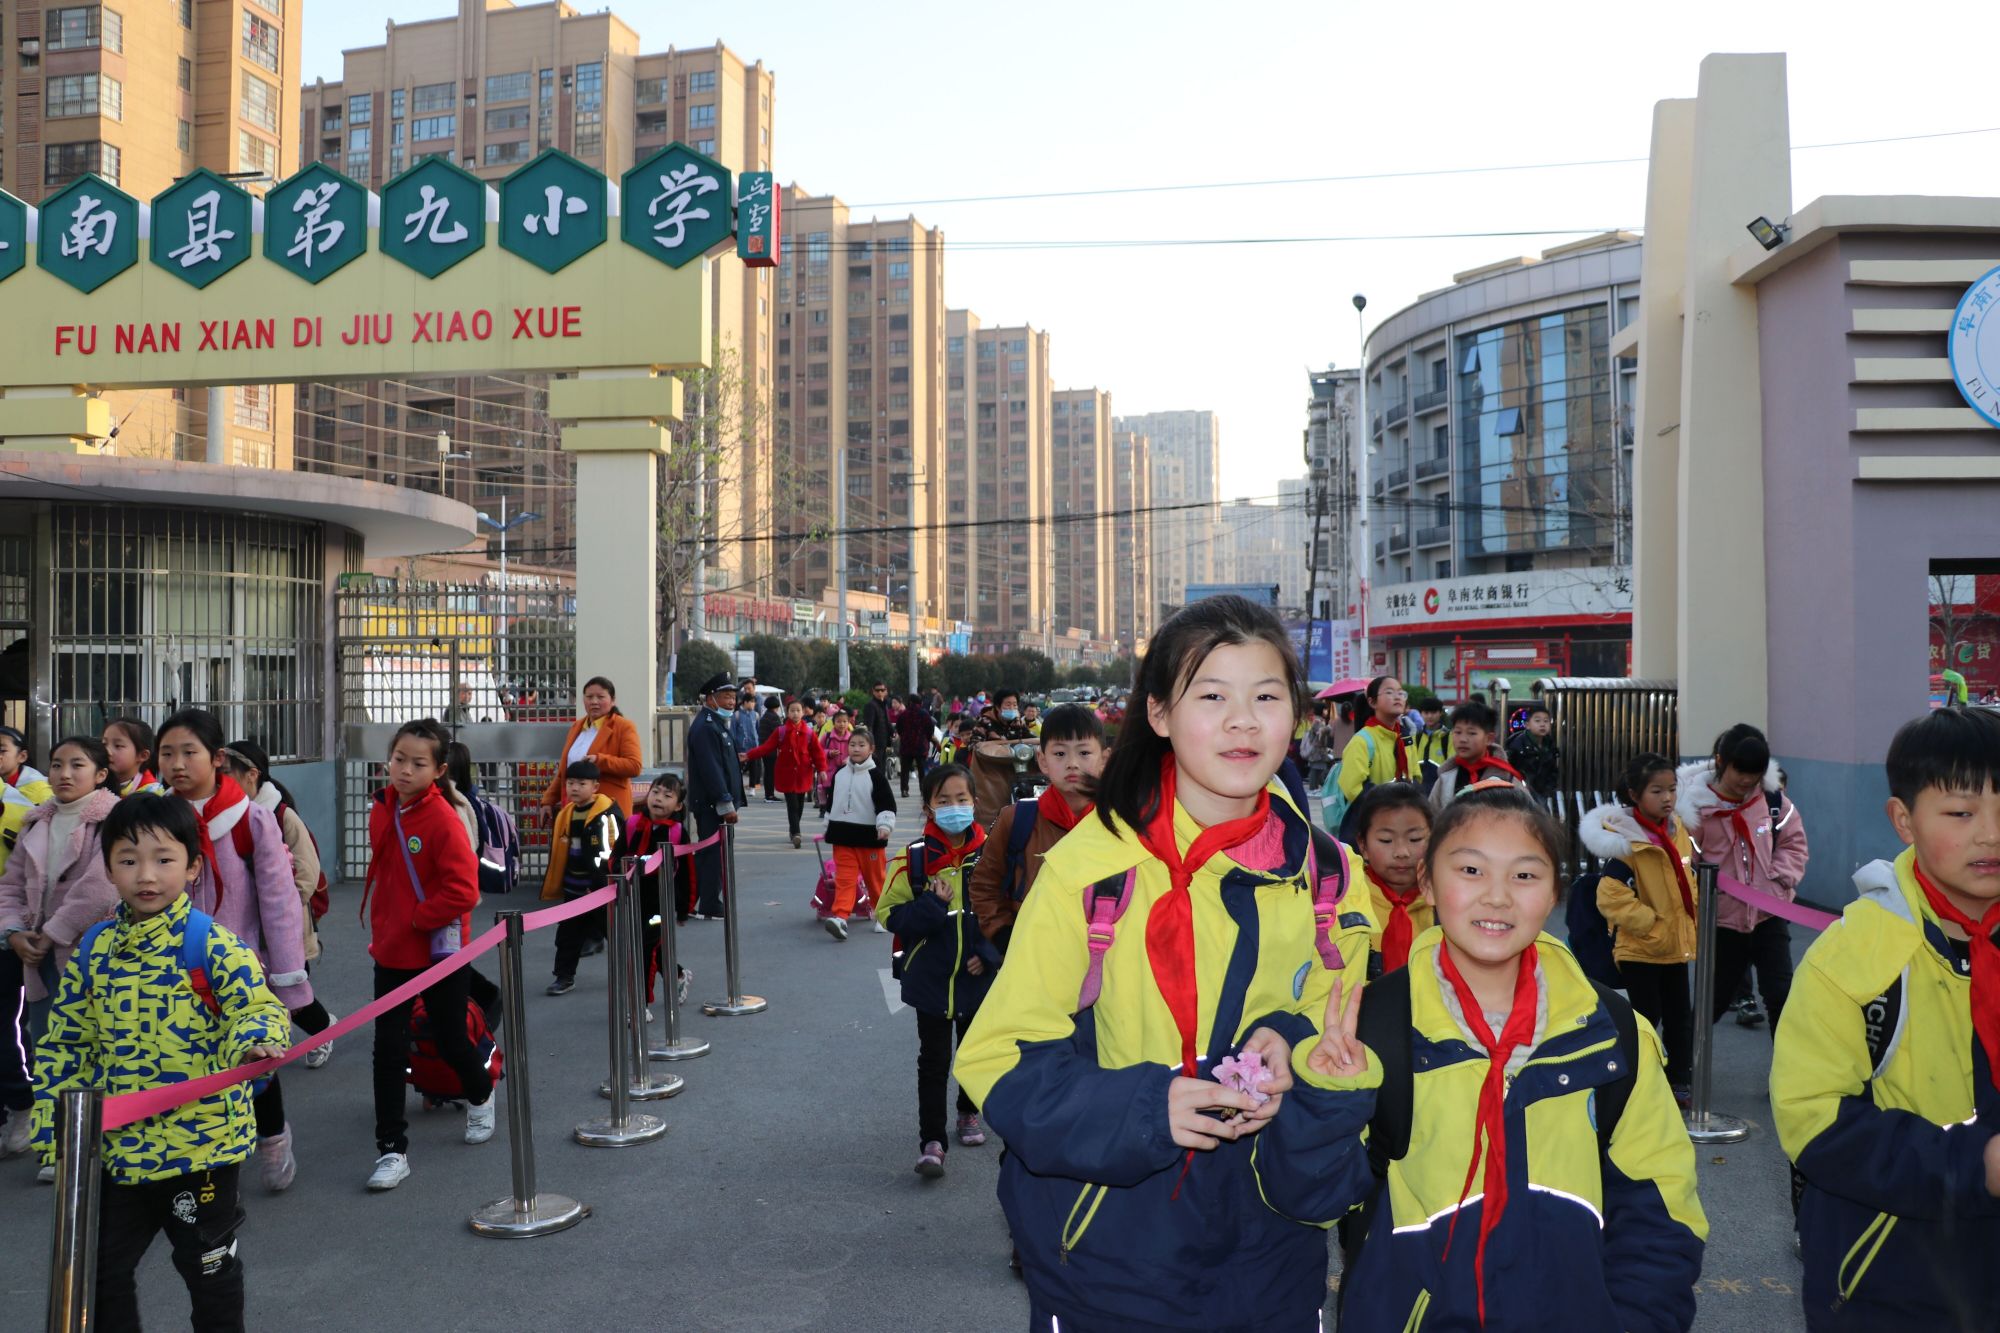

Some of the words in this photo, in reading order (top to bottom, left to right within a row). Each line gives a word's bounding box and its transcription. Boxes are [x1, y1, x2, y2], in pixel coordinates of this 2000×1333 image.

[0, 163, 718, 268] 南县第九小学
[1958, 274, 2000, 337] 阜南
[56, 325, 96, 354] FU
[115, 323, 180, 353] NAN
[200, 319, 274, 350] XIAN
[294, 318, 322, 346] DI
[342, 314, 392, 345] JIU
[413, 310, 493, 341] XIAO
[514, 306, 581, 338] XUE
[1966, 377, 1986, 400] FU
[1448, 583, 1528, 602] 阜南农商银行
